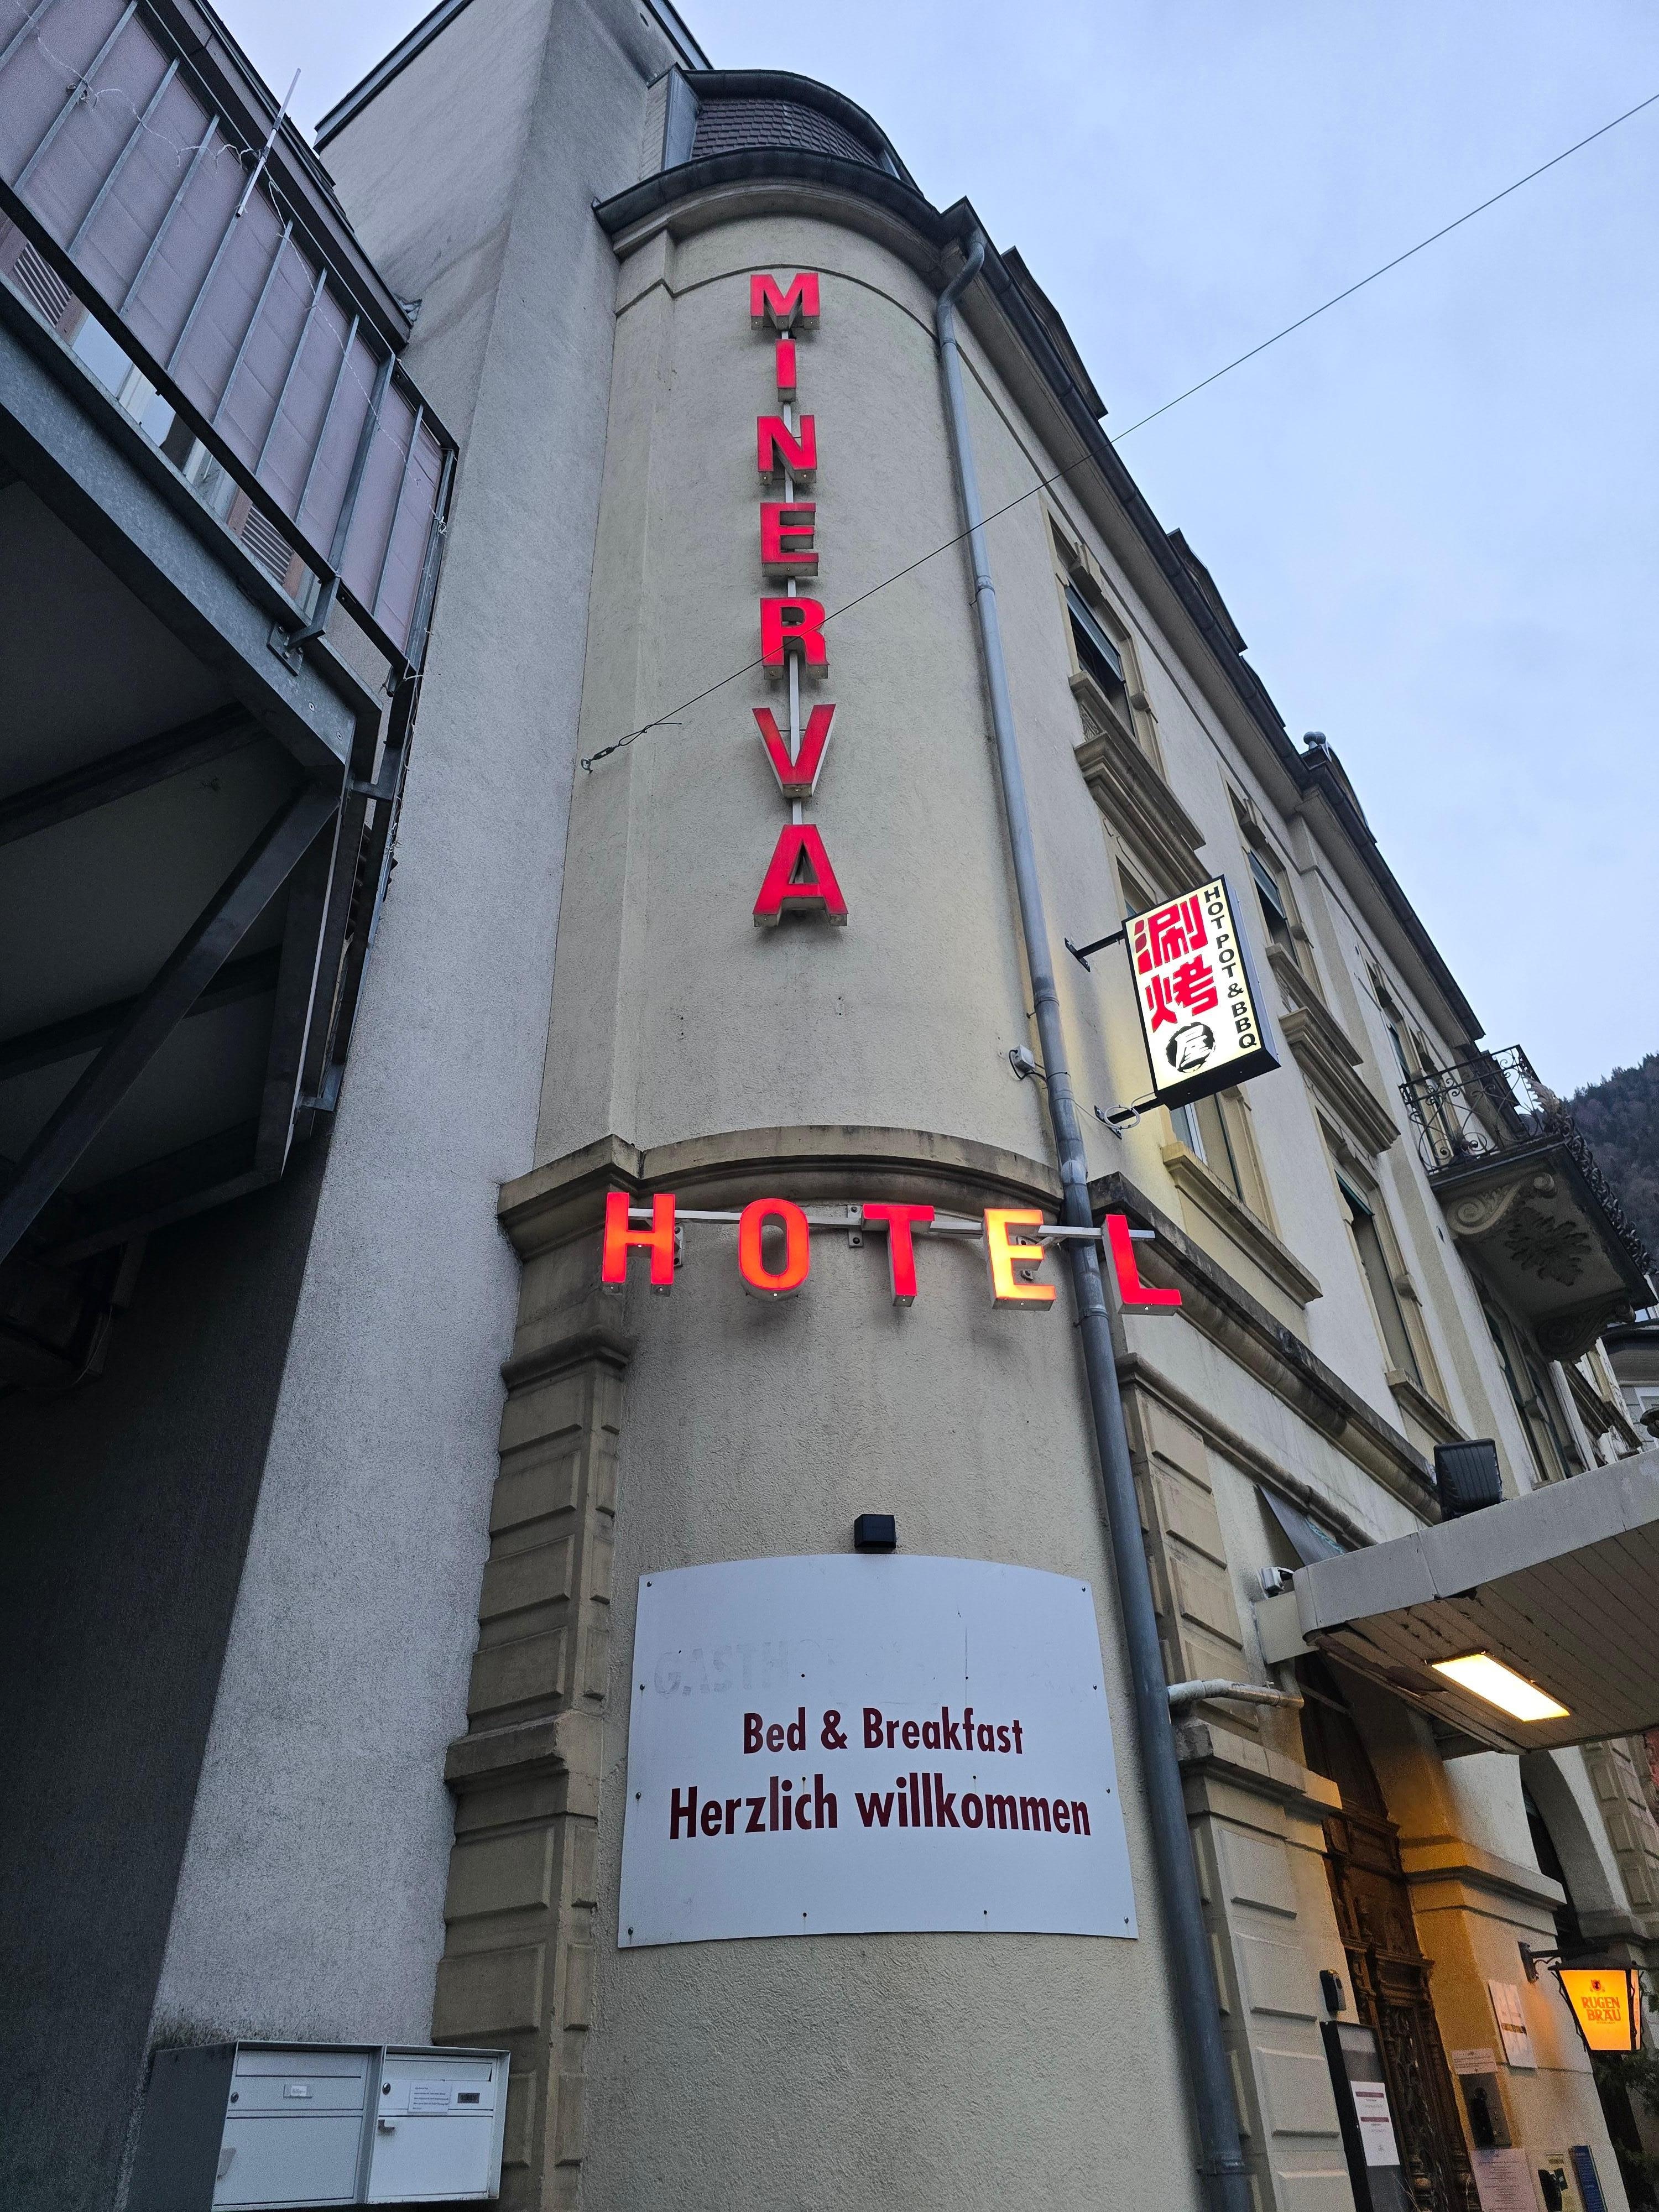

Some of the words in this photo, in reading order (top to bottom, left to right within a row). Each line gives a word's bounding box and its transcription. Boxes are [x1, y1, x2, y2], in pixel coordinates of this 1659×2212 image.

[750, 272, 849, 916] MINERVA
[1203, 886, 1225, 930] HOT
[1215, 933, 1237, 978] POT
[1227, 983, 1244, 998] &
[1231, 1001, 1258, 1049] BBQ
[601, 1192, 1182, 1306] HOTEL
[744, 1707, 806, 1754] Bed
[821, 1709, 848, 1750] &
[863, 1707, 1023, 1754] Breakfast
[670, 1774, 838, 1840] Herzlich
[855, 1773, 1091, 1836] willkommen
[1581, 1997, 1620, 2008] RUGEN
